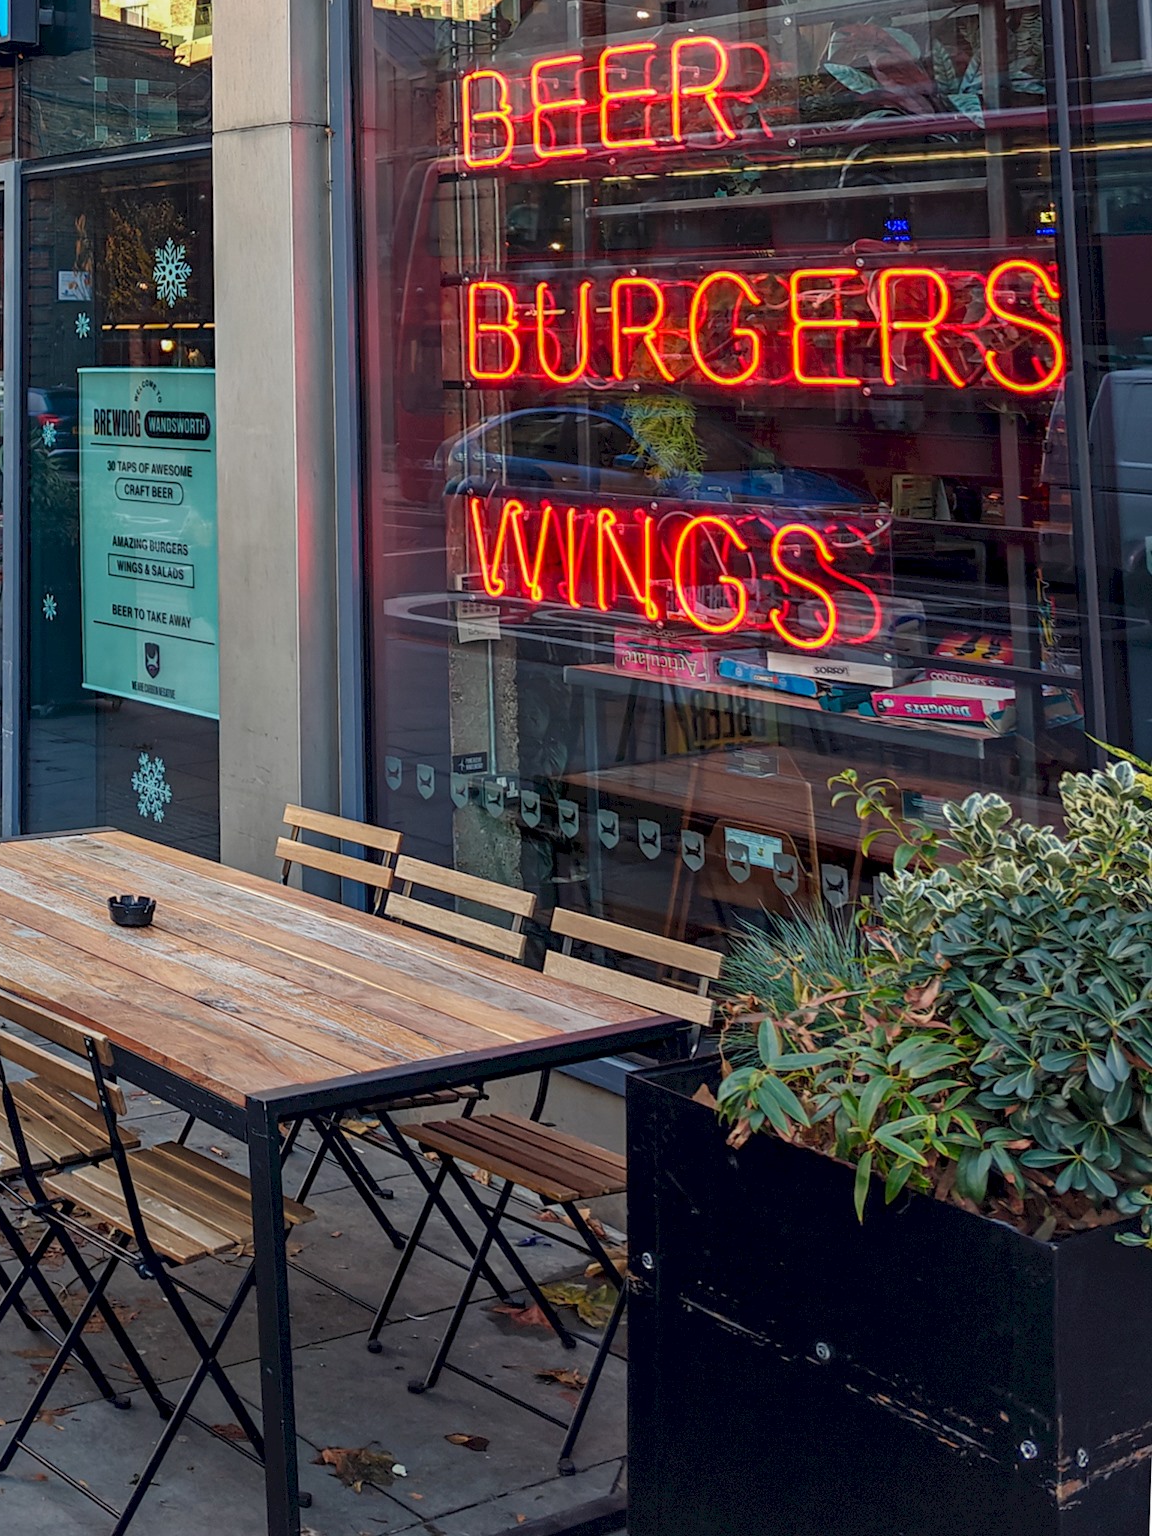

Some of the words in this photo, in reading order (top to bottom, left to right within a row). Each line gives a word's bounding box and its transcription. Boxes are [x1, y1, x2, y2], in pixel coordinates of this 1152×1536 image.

[459, 33, 739, 169] BEER
[465, 258, 1067, 393] BURGERS
[133, 379, 157, 402] WELCOME
[93, 408, 141, 438] BREWDOG
[148, 415, 207, 435] WANDSWORTH
[117, 461, 137, 473] TAPS
[138, 462, 150, 474] OF
[151, 463, 193, 478] AWESOME
[124, 483, 150, 498] CRAFT
[152, 485, 174, 500] BEER
[112, 535, 148, 551] AMAZING
[149, 540, 189, 556] BURGERS
[116, 559, 143, 575] WINGS
[144, 564, 150, 575] &
[151, 565, 185, 580] SALADS
[468, 495, 839, 650] WINGS
[112, 603, 133, 619] BEER
[134, 607, 145, 620] TO
[147, 610, 168, 624] TAKE
[169, 613, 192, 629] AWAY
[904, 702, 972, 718] DRAUGHTS
